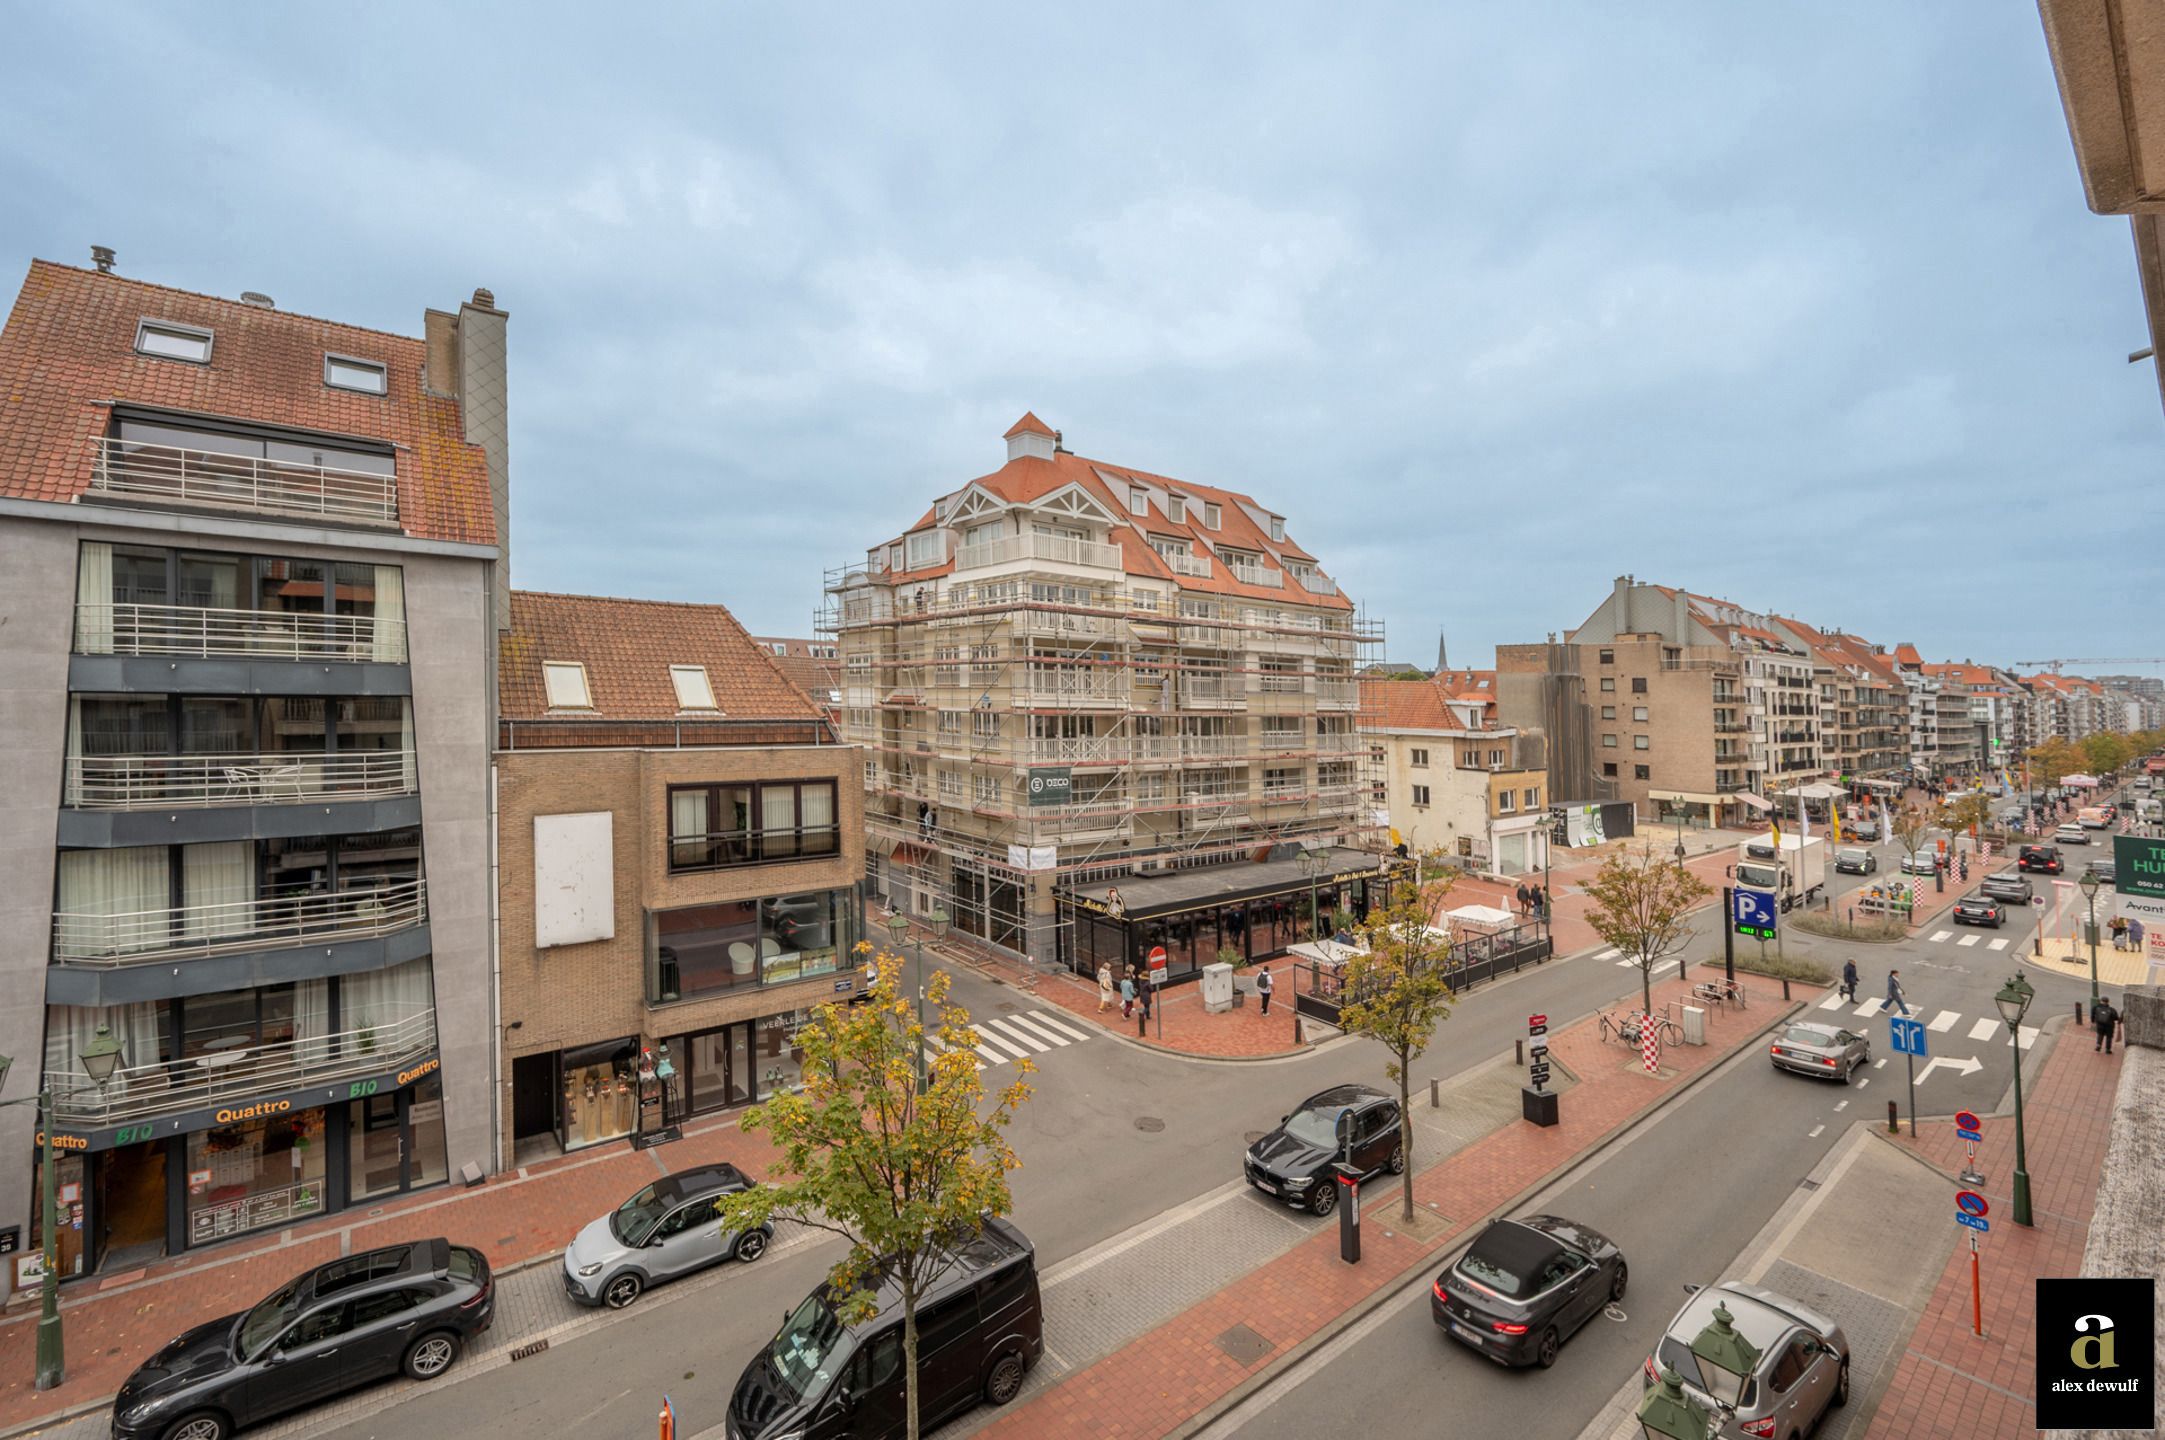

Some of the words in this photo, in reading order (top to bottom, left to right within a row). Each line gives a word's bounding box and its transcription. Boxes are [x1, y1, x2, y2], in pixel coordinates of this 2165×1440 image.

[2133, 859, 2165, 873] HU
[1738, 896, 1756, 920] P
[397, 1058, 440, 1086] Quattro
[350, 1079, 378, 1098] BIO
[215, 1099, 291, 1124] Quattro
[114, 1123, 154, 1146] BIO
